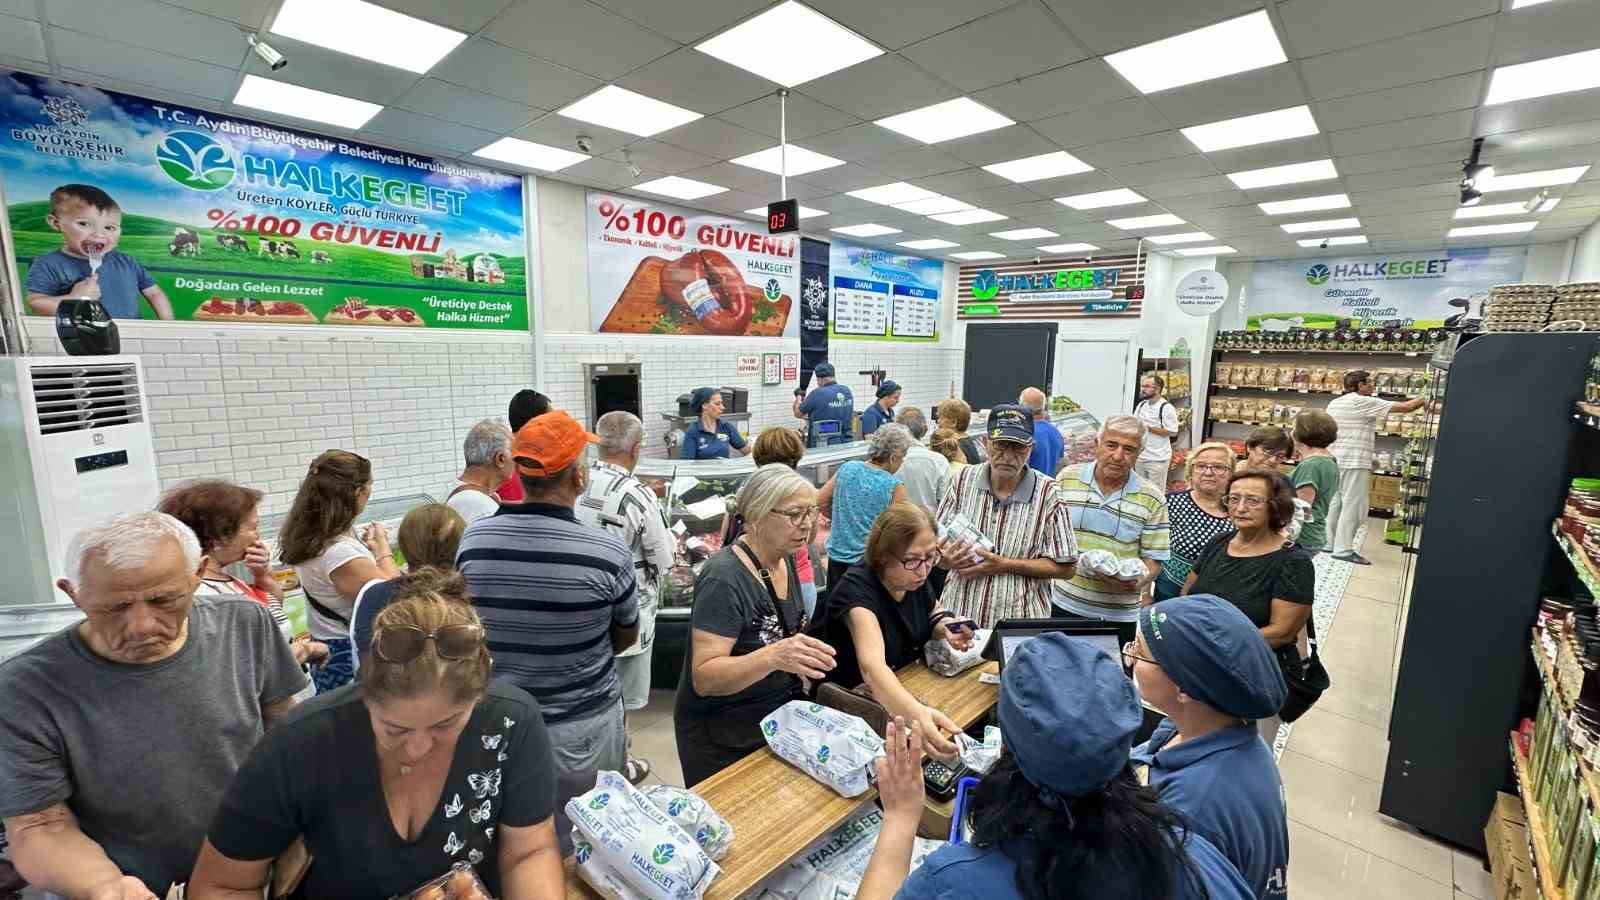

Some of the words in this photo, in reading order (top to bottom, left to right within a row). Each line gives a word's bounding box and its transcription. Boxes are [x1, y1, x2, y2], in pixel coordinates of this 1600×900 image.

[153, 106, 190, 124] T.C.
[196, 116, 247, 134] Aydın
[251, 127, 336, 152] Büyükşehir
[339, 144, 404, 166] Belediyesi
[242, 154, 468, 217] HALKEGEET
[207, 207, 301, 239] %100
[310, 219, 443, 254] GÜVENLİ
[599, 200, 687, 240] %100
[697, 223, 796, 258] GÜVENLİ
[771, 213, 786, 229] 03
[747, 259, 793, 274] HALKEGEET
[1333, 258, 1452, 277] HALKEGEET
[175, 278, 240, 292] Doğadan
[242, 281, 281, 294] Gelen
[284, 284, 325, 296] Lezzet
[479, 299, 513, 312] Destek
[437, 311, 467, 322] Halka
[632, 852, 674, 889] HALKEGEET
